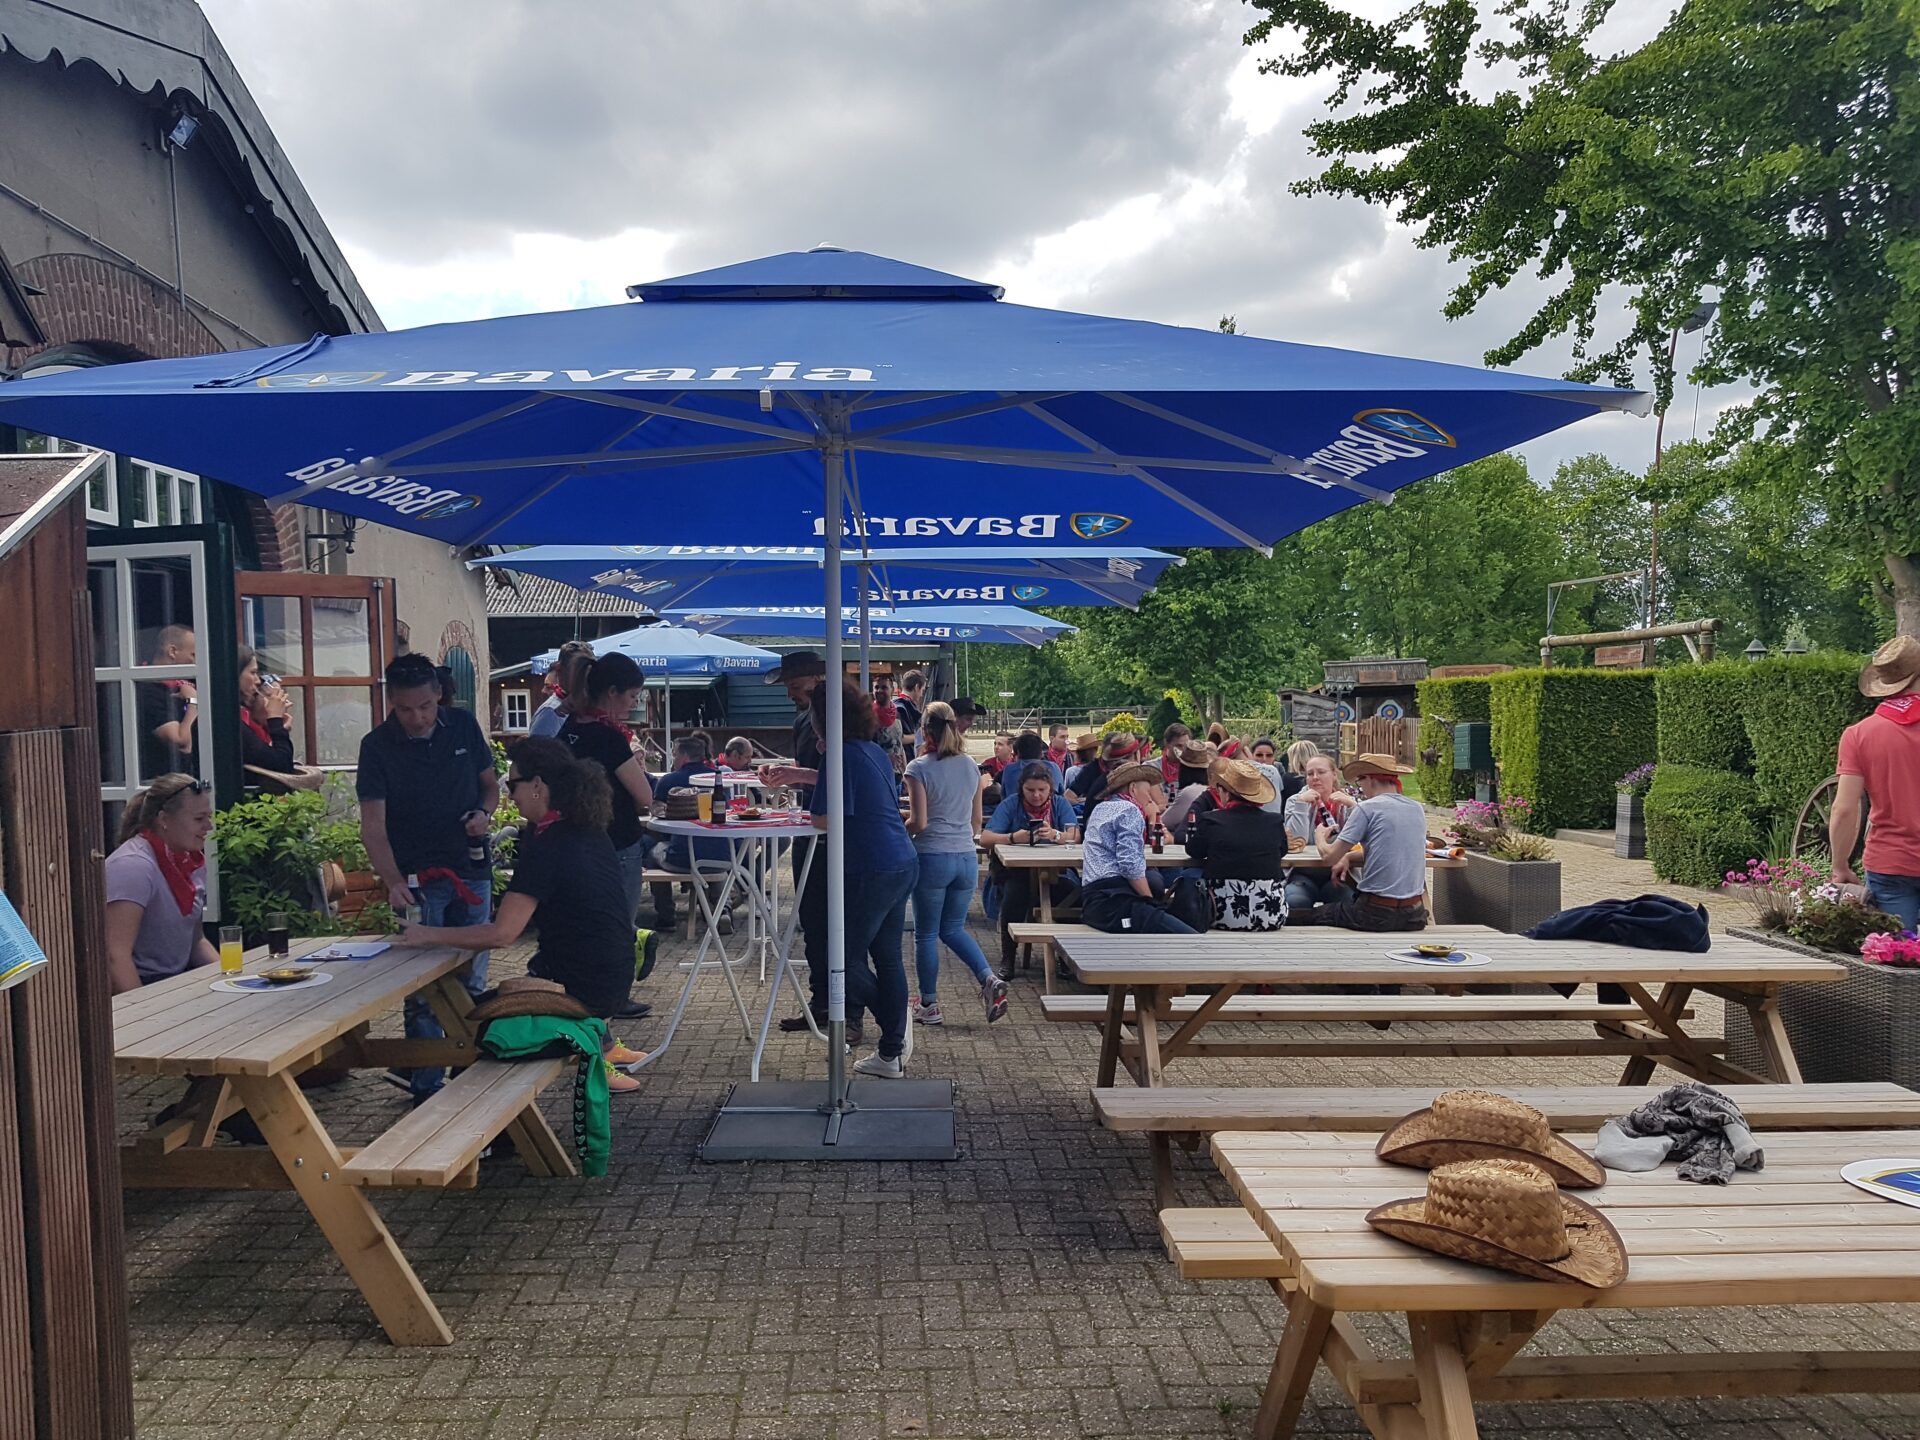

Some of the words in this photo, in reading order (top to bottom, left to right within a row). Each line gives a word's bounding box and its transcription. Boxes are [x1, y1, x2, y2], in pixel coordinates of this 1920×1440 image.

[380, 361, 878, 386] Bavaria
[631, 655, 668, 667] varia
[723, 656, 760, 668] Bavaria
